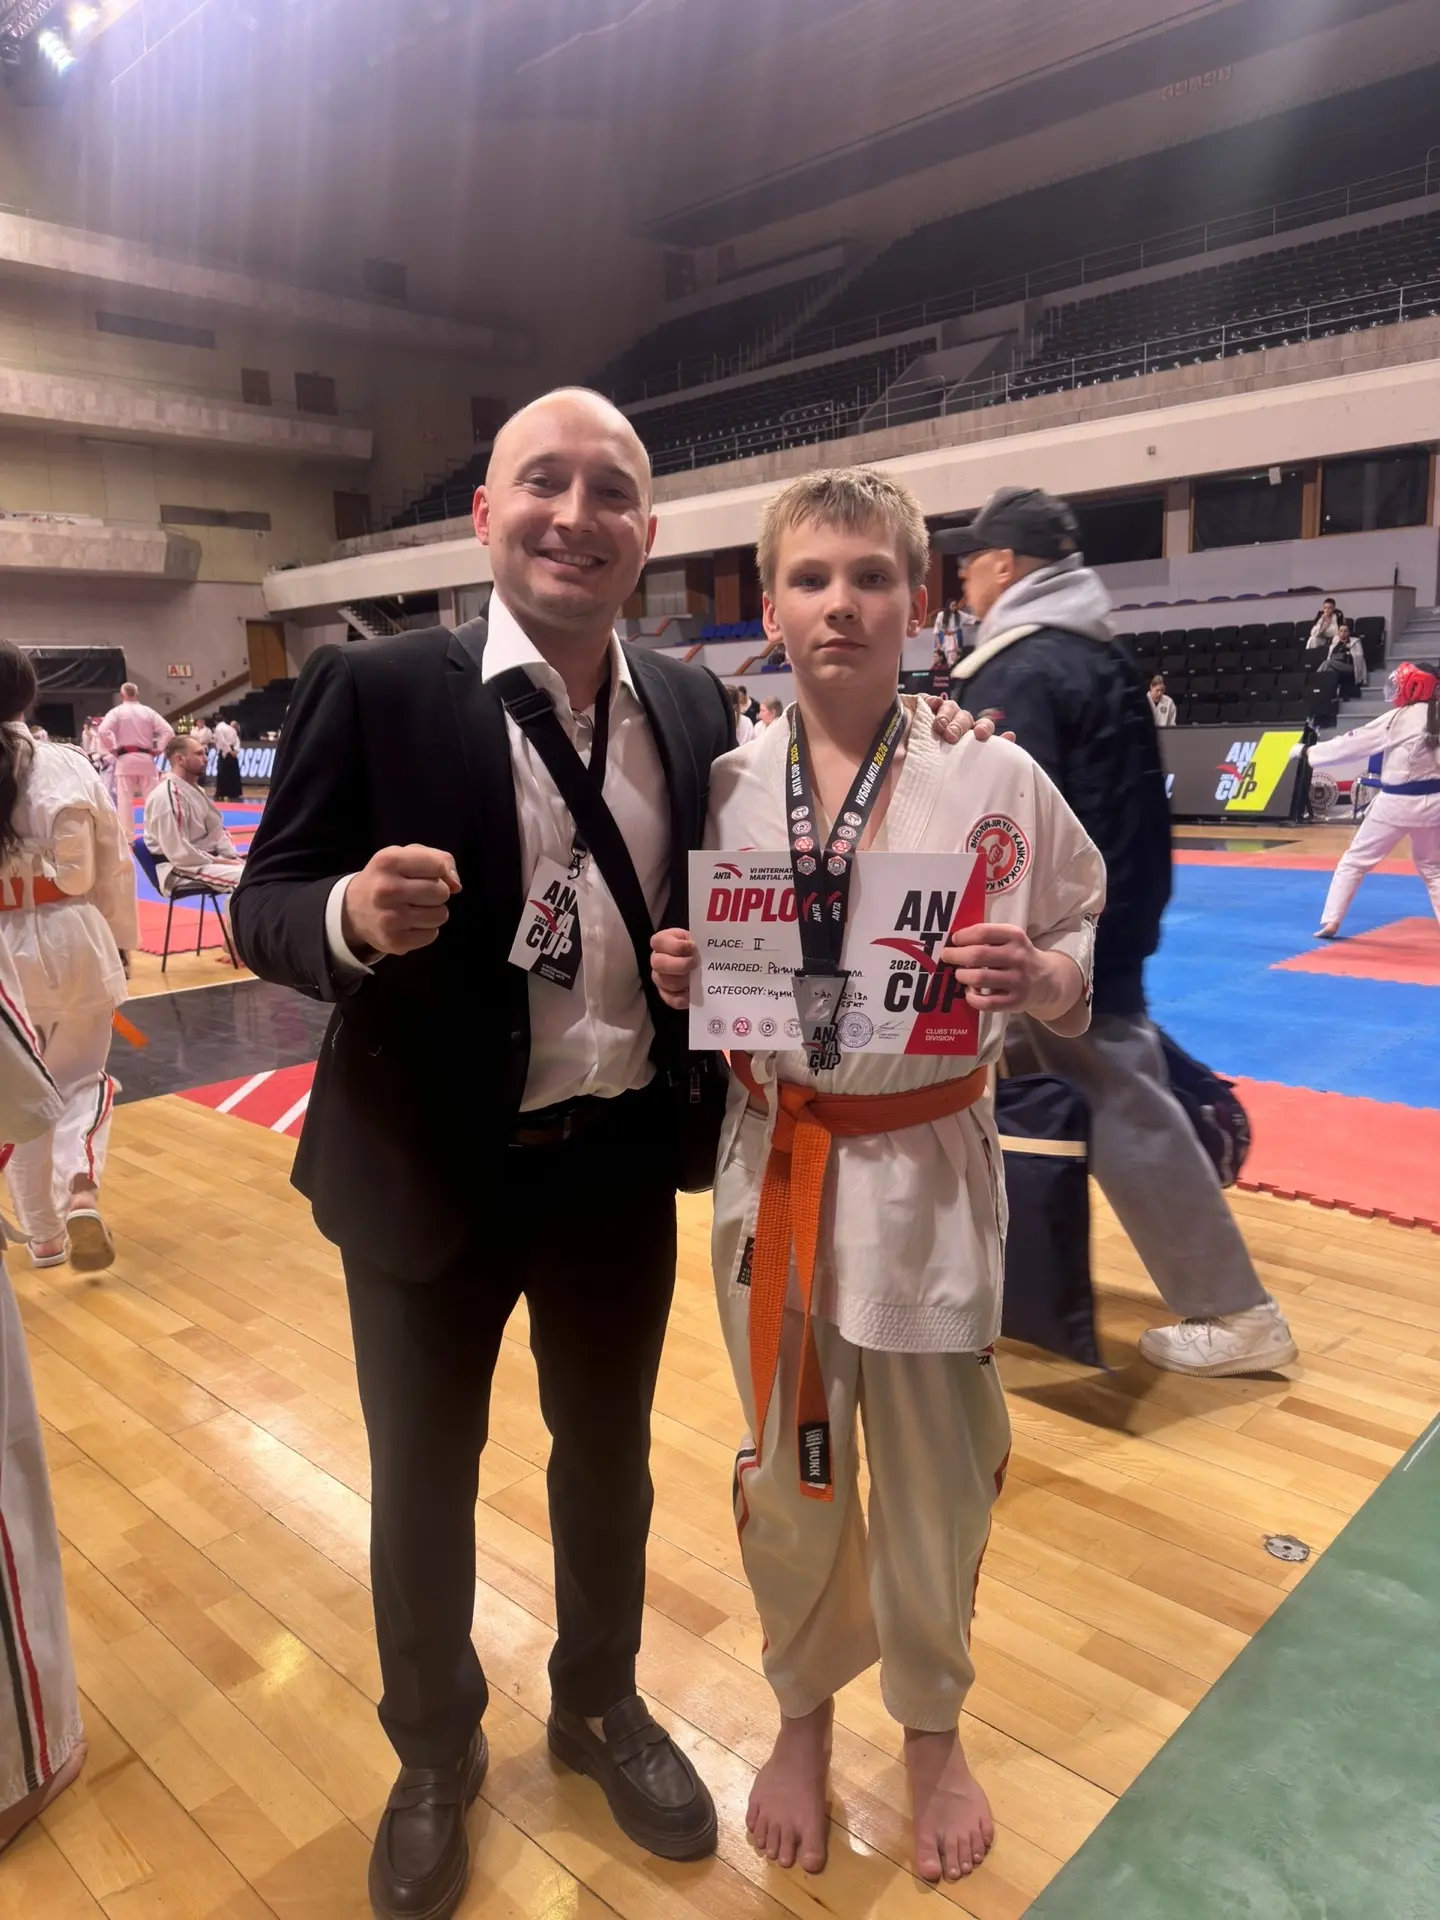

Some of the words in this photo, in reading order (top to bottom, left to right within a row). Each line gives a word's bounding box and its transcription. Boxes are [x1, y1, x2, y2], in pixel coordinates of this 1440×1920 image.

[874, 743, 889, 767] 2026
[1225, 742, 1257, 762] AN
[791, 764, 800, 777] CUP
[869, 761, 881, 785] АНТА
[1236, 762, 1257, 780] TA
[792, 777, 803, 797] ANTA
[854, 777, 873, 807] КУБОК
[1215, 780, 1258, 801] CUP
[970, 819, 1013, 849] SHORINJIRYU
[997, 832, 1027, 888] KANKEOKAN
[713, 872, 732, 880] ANTA
[543, 880, 577, 912] AN
[534, 914, 549, 927] 2026
[811, 903, 823, 923] ANTA
[831, 901, 842, 922] ANTA
[894, 890, 957, 932] AN
[550, 906, 575, 939] TA
[525, 923, 573, 960] CUP
[707, 939, 744, 949] PLACE:
[753, 938, 765, 950] II
[707, 962, 763, 972] AWARDED:
[889, 960, 917, 971] 2026
[707, 986, 767, 996] CATEGORY:
[812, 1026, 835, 1041] AN
[925, 1034, 955, 1042] DIVISION
[809, 1053, 841, 1070] CUP
